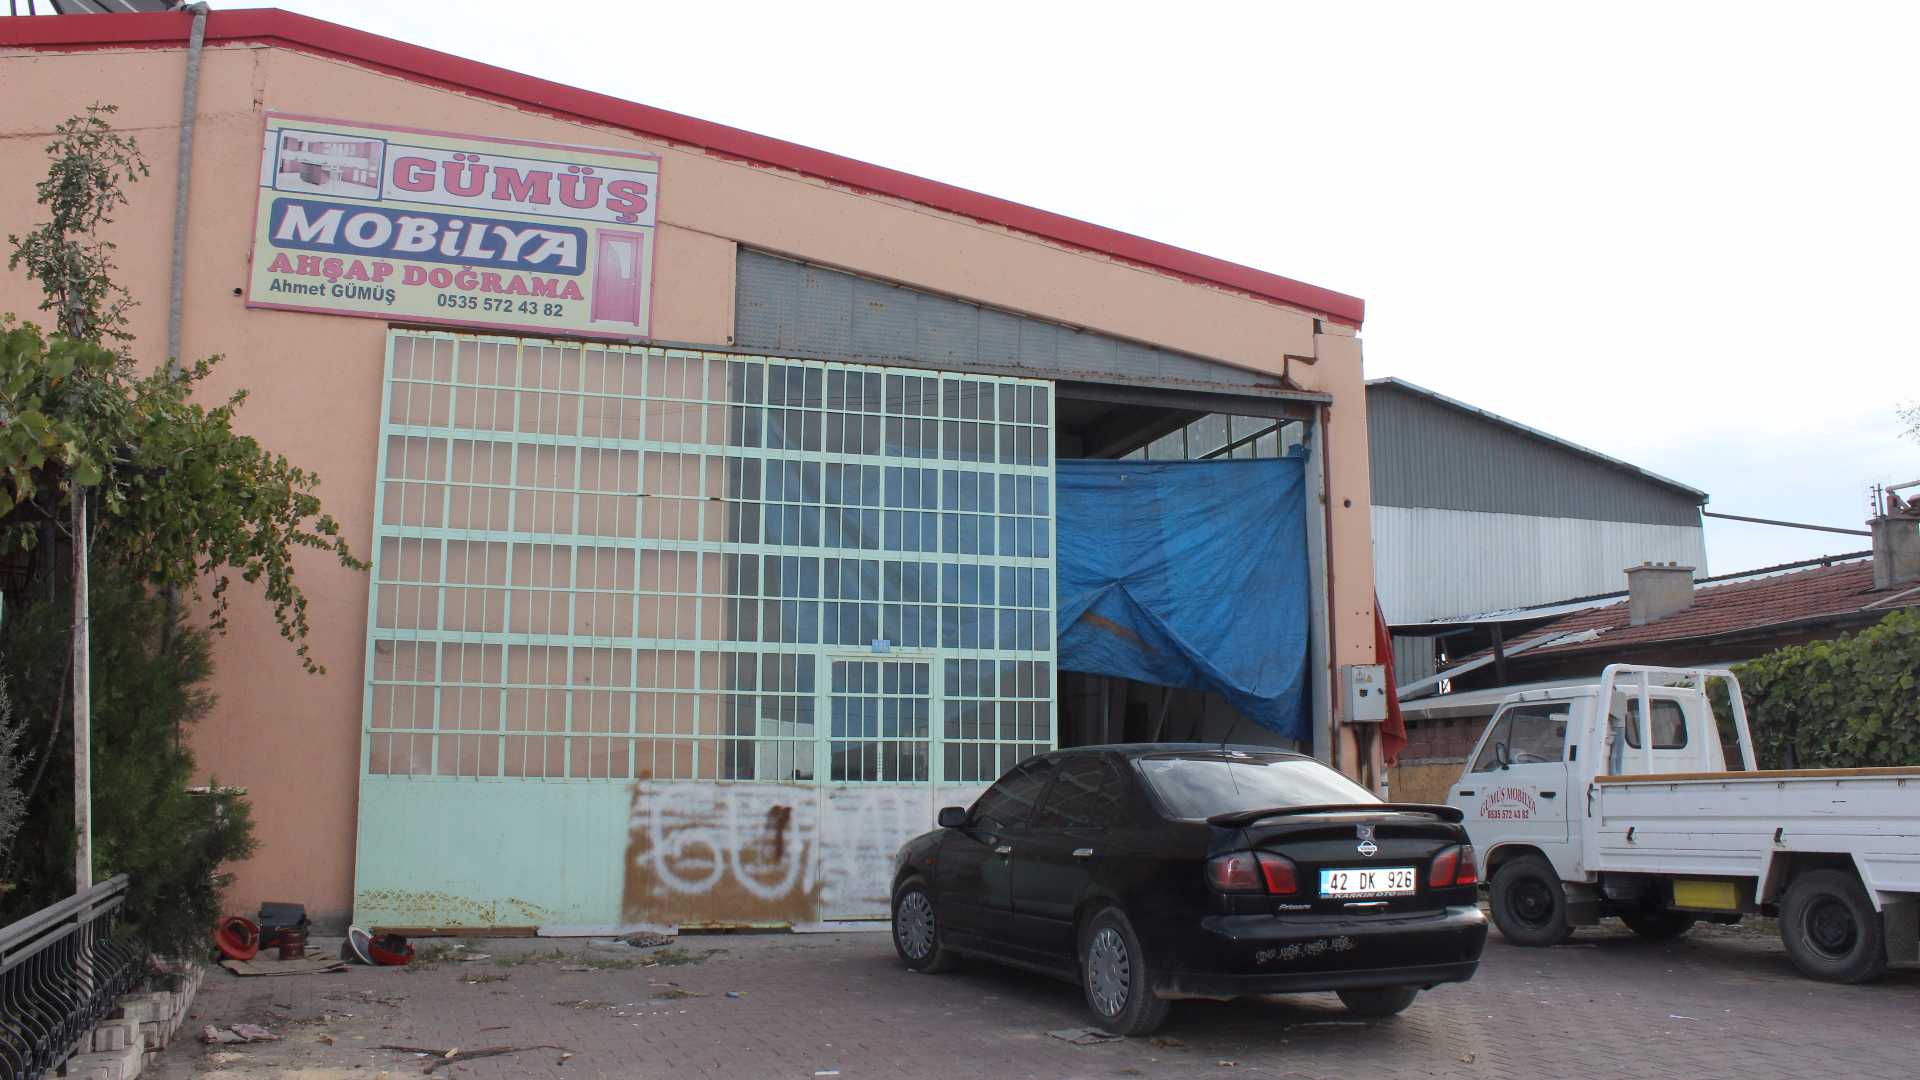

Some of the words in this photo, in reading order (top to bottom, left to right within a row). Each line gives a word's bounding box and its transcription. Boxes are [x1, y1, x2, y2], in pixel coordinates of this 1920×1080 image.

[392, 152, 649, 223] GÜMÜŞ
[267, 252, 394, 283] AHŞAP
[402, 264, 584, 301] DOĞRAMA
[269, 278, 326, 296] Ahmet
[331, 282, 396, 306] GÜMÜŞ
[437, 293, 478, 310] 0535
[483, 298, 513, 313] 572
[518, 301, 538, 315] 43
[543, 303, 563, 317] 82
[1502, 810, 1512, 818] 572
[1330, 873, 1348, 890] 42
[1359, 872, 1376, 889] DK
[1388, 871, 1412, 889] 926
